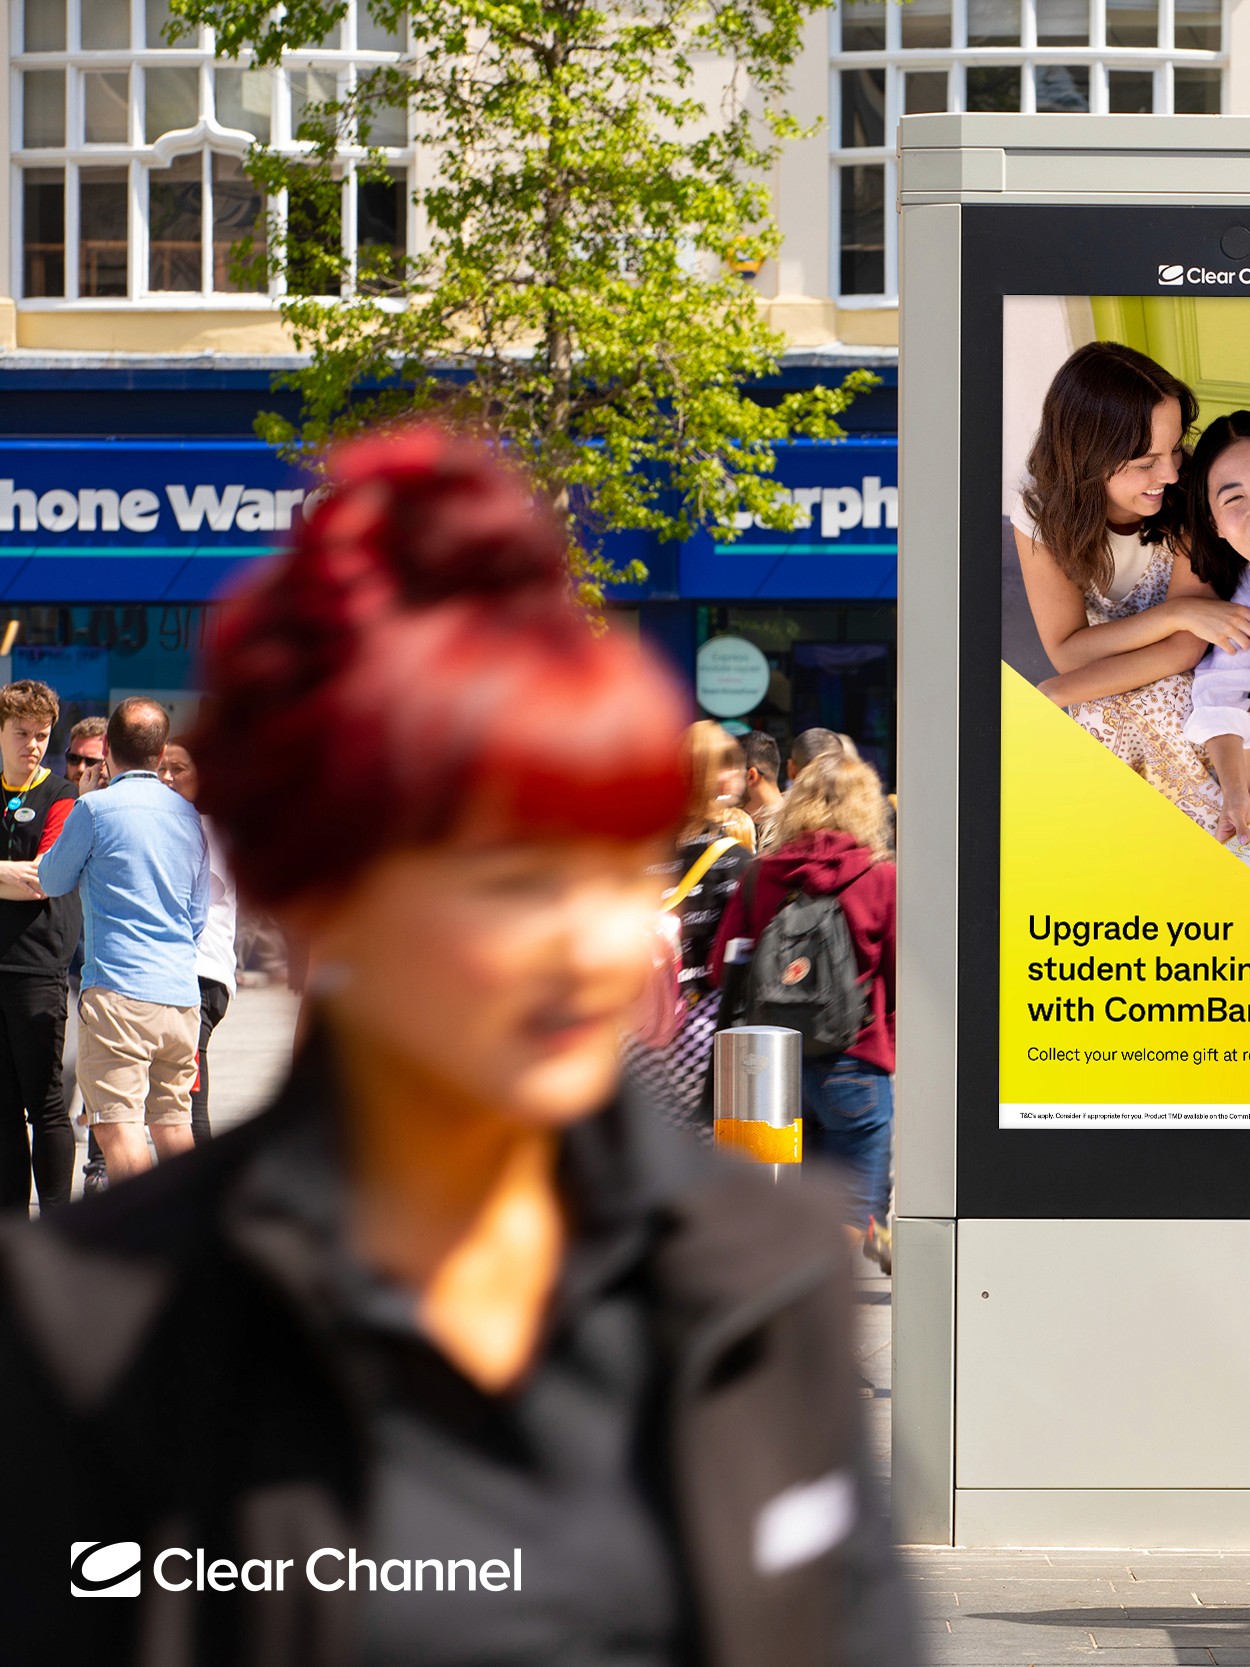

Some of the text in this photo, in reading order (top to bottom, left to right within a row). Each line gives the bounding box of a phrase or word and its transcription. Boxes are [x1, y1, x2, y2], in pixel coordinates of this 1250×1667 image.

[1186, 266, 1236, 285] Clear
[1029, 914, 1234, 947] Upgrade your
[1028, 956, 1147, 982] student
[1027, 996, 1095, 1023] with
[1027, 1046, 1080, 1062] Collect
[1084, 1050, 1118, 1065] your
[1121, 1047, 1189, 1062] welcome
[1192, 1047, 1219, 1065] gift
[1223, 1048, 1238, 1062] at
